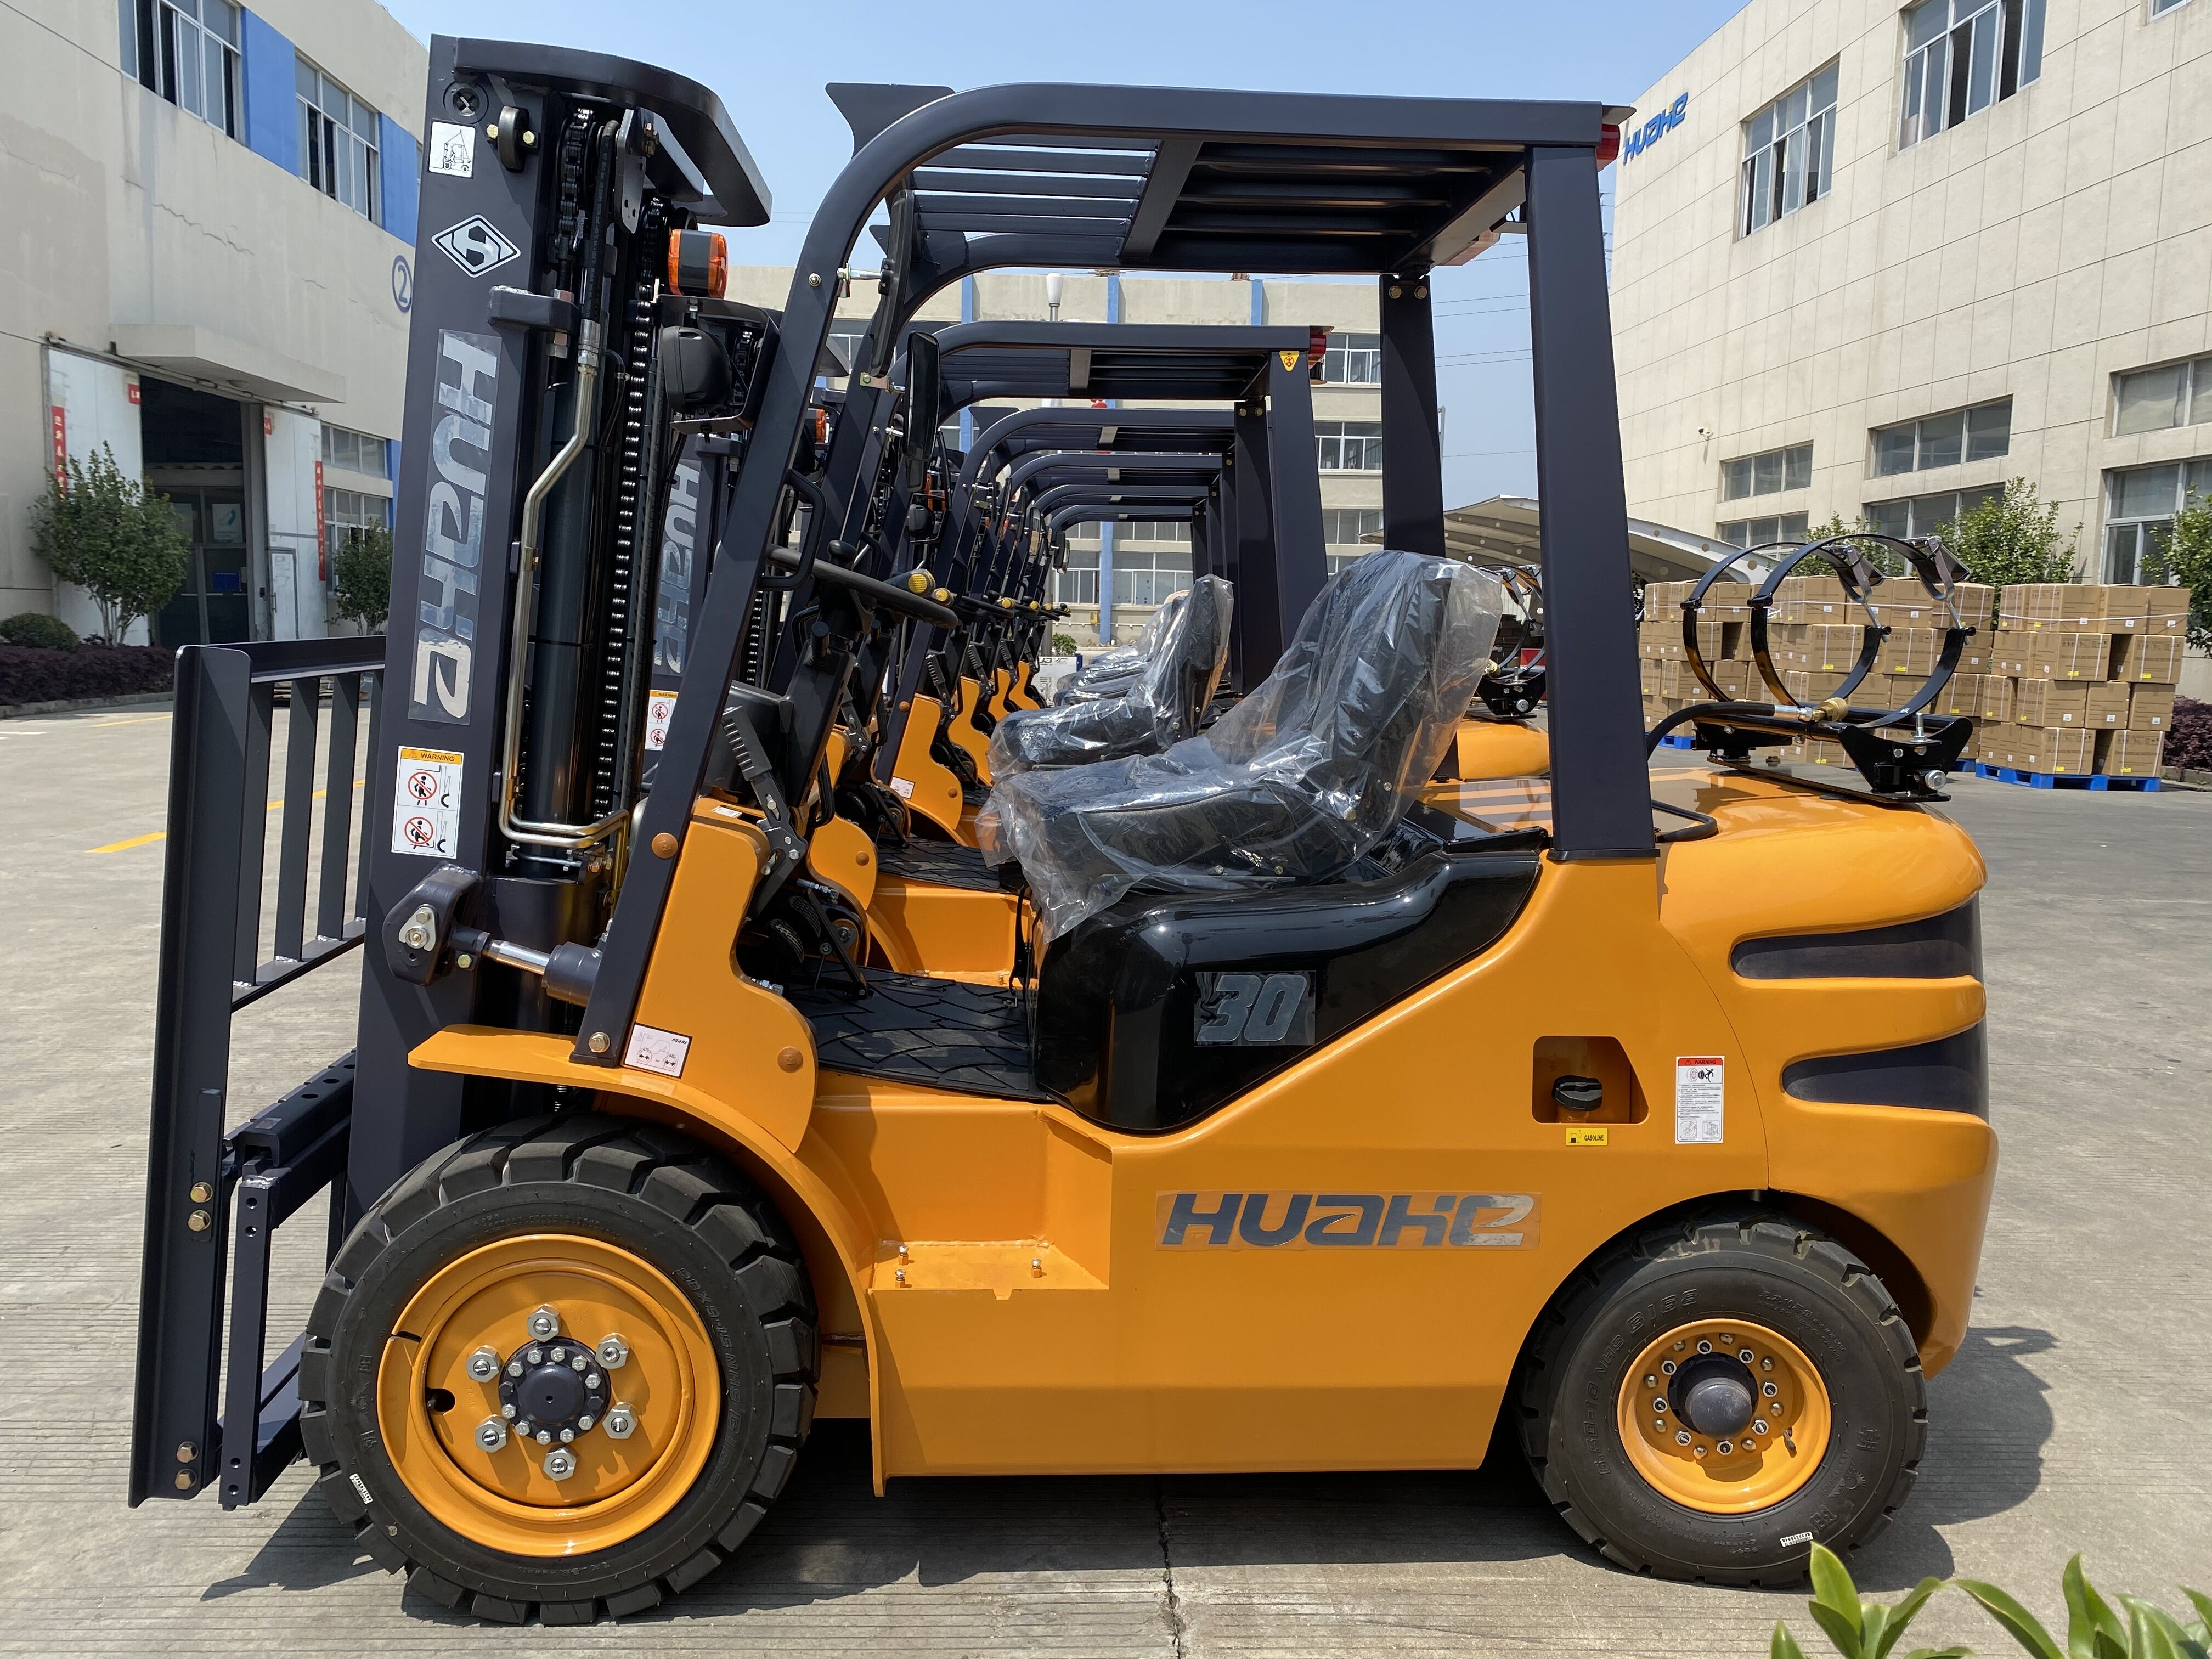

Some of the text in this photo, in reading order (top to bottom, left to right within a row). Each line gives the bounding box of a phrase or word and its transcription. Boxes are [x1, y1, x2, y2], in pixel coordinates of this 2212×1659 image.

[1623, 92, 1688, 166] HUAHE
[414, 334, 498, 719] HUAHE
[421, 752, 454, 761] WARNING
[1196, 974, 1308, 1043] 30
[1161, 1192, 1535, 1247] HUAHE
[725, 1352, 741, 1403] NHS
[1594, 1334, 1625, 1380] NHS
[1584, 1381, 1611, 1475] 6.50-10
